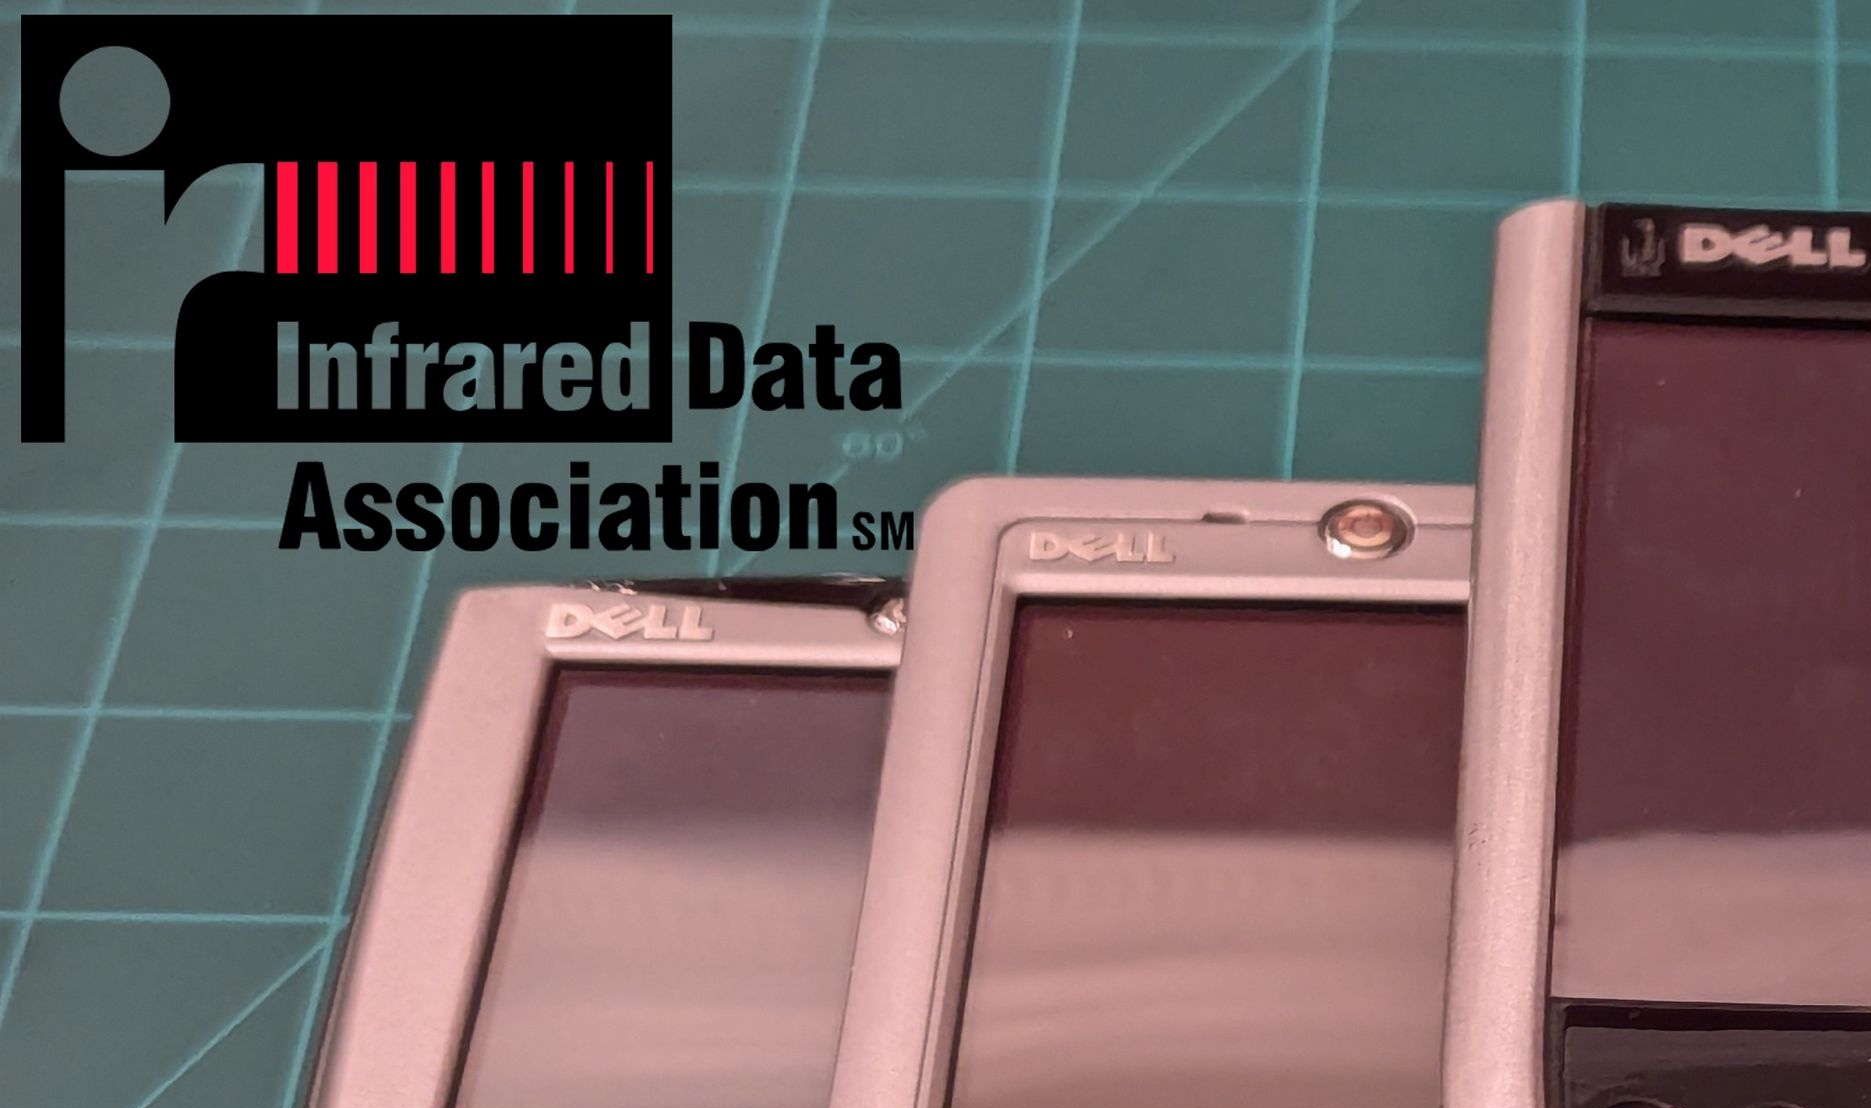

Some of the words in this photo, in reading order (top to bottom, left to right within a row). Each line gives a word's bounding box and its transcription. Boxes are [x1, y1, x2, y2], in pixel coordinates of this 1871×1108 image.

[1681, 222, 1867, 268] DELL
[1028, 531, 1175, 562] DELL
[545, 603, 714, 640] DELL
